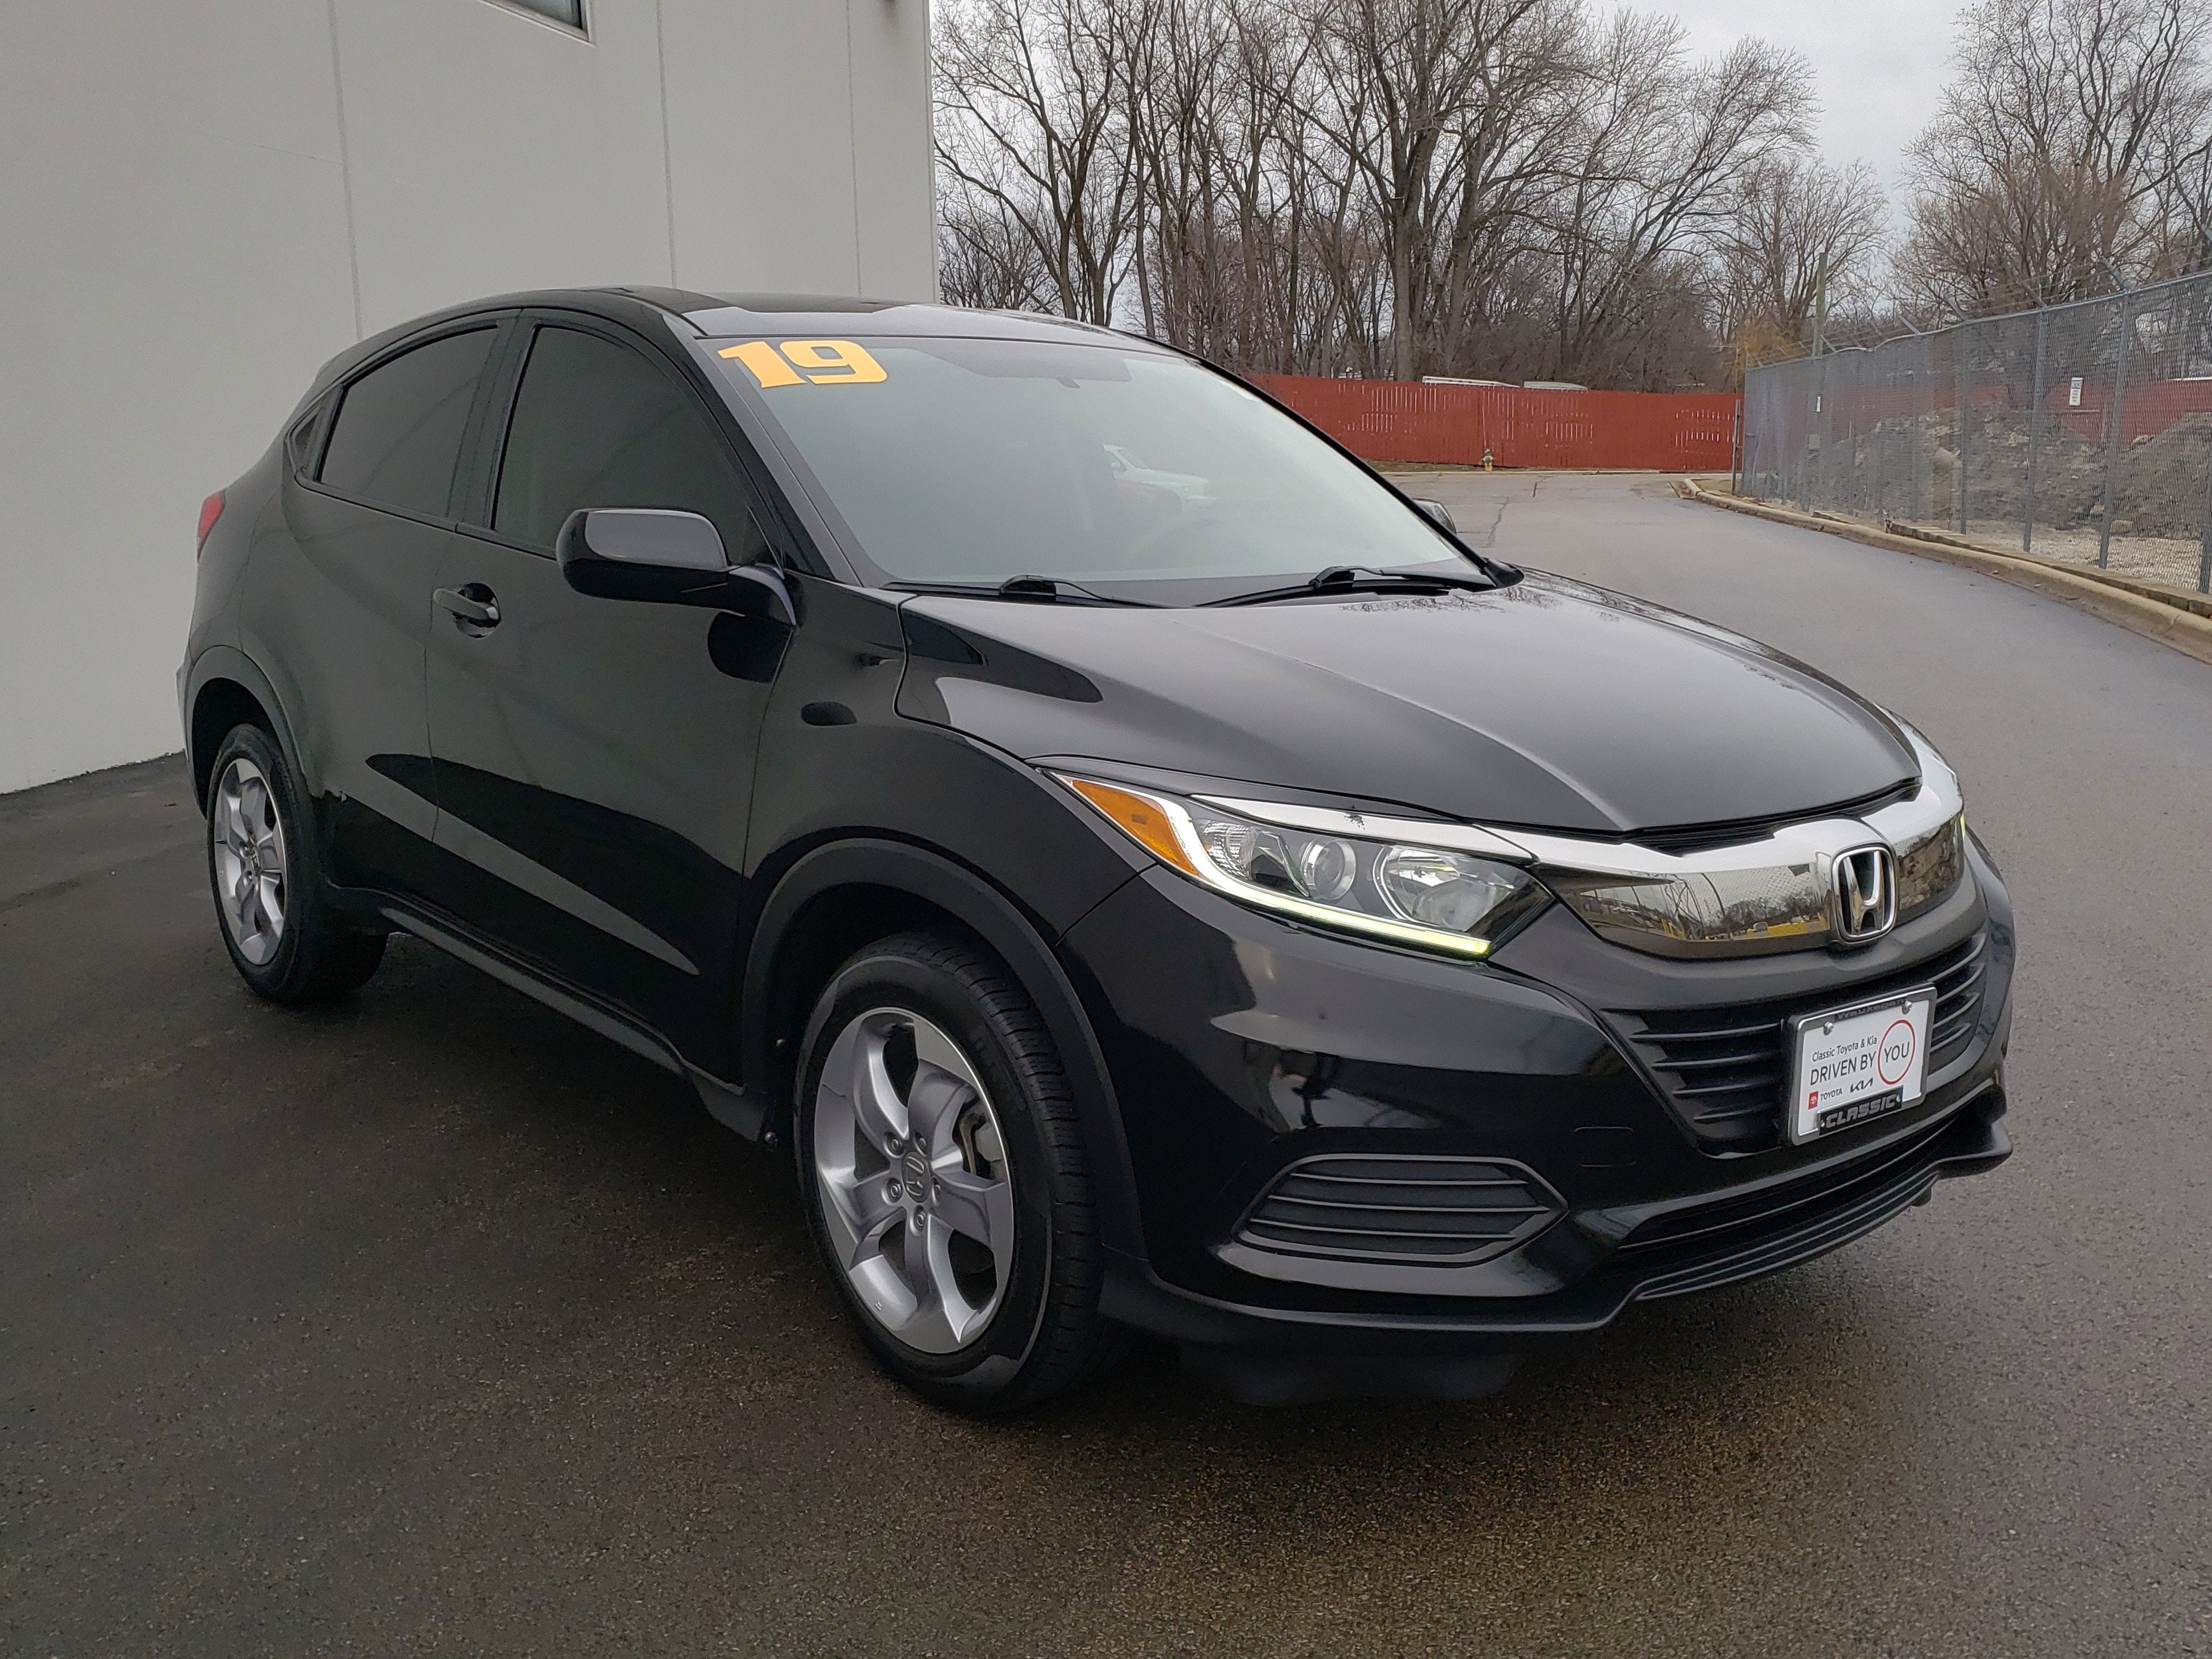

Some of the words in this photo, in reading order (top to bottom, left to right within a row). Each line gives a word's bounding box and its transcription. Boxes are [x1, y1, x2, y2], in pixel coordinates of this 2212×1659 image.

[717, 340, 888, 388] 19
[1810, 1057, 1857, 1086] DRIVEN
[1860, 1051, 1877, 1071] BY
[1884, 1041, 1910, 1063] YOU
[1812, 1047, 1835, 1062] Classic
[1837, 1042, 1859, 1055] Toyota
[1860, 1039, 1865, 1048] &
[1867, 1035, 1877, 1046] Kia
[1820, 1088, 1843, 1101] TOYOTA
[1826, 1093, 1897, 1128] CLASSIC
